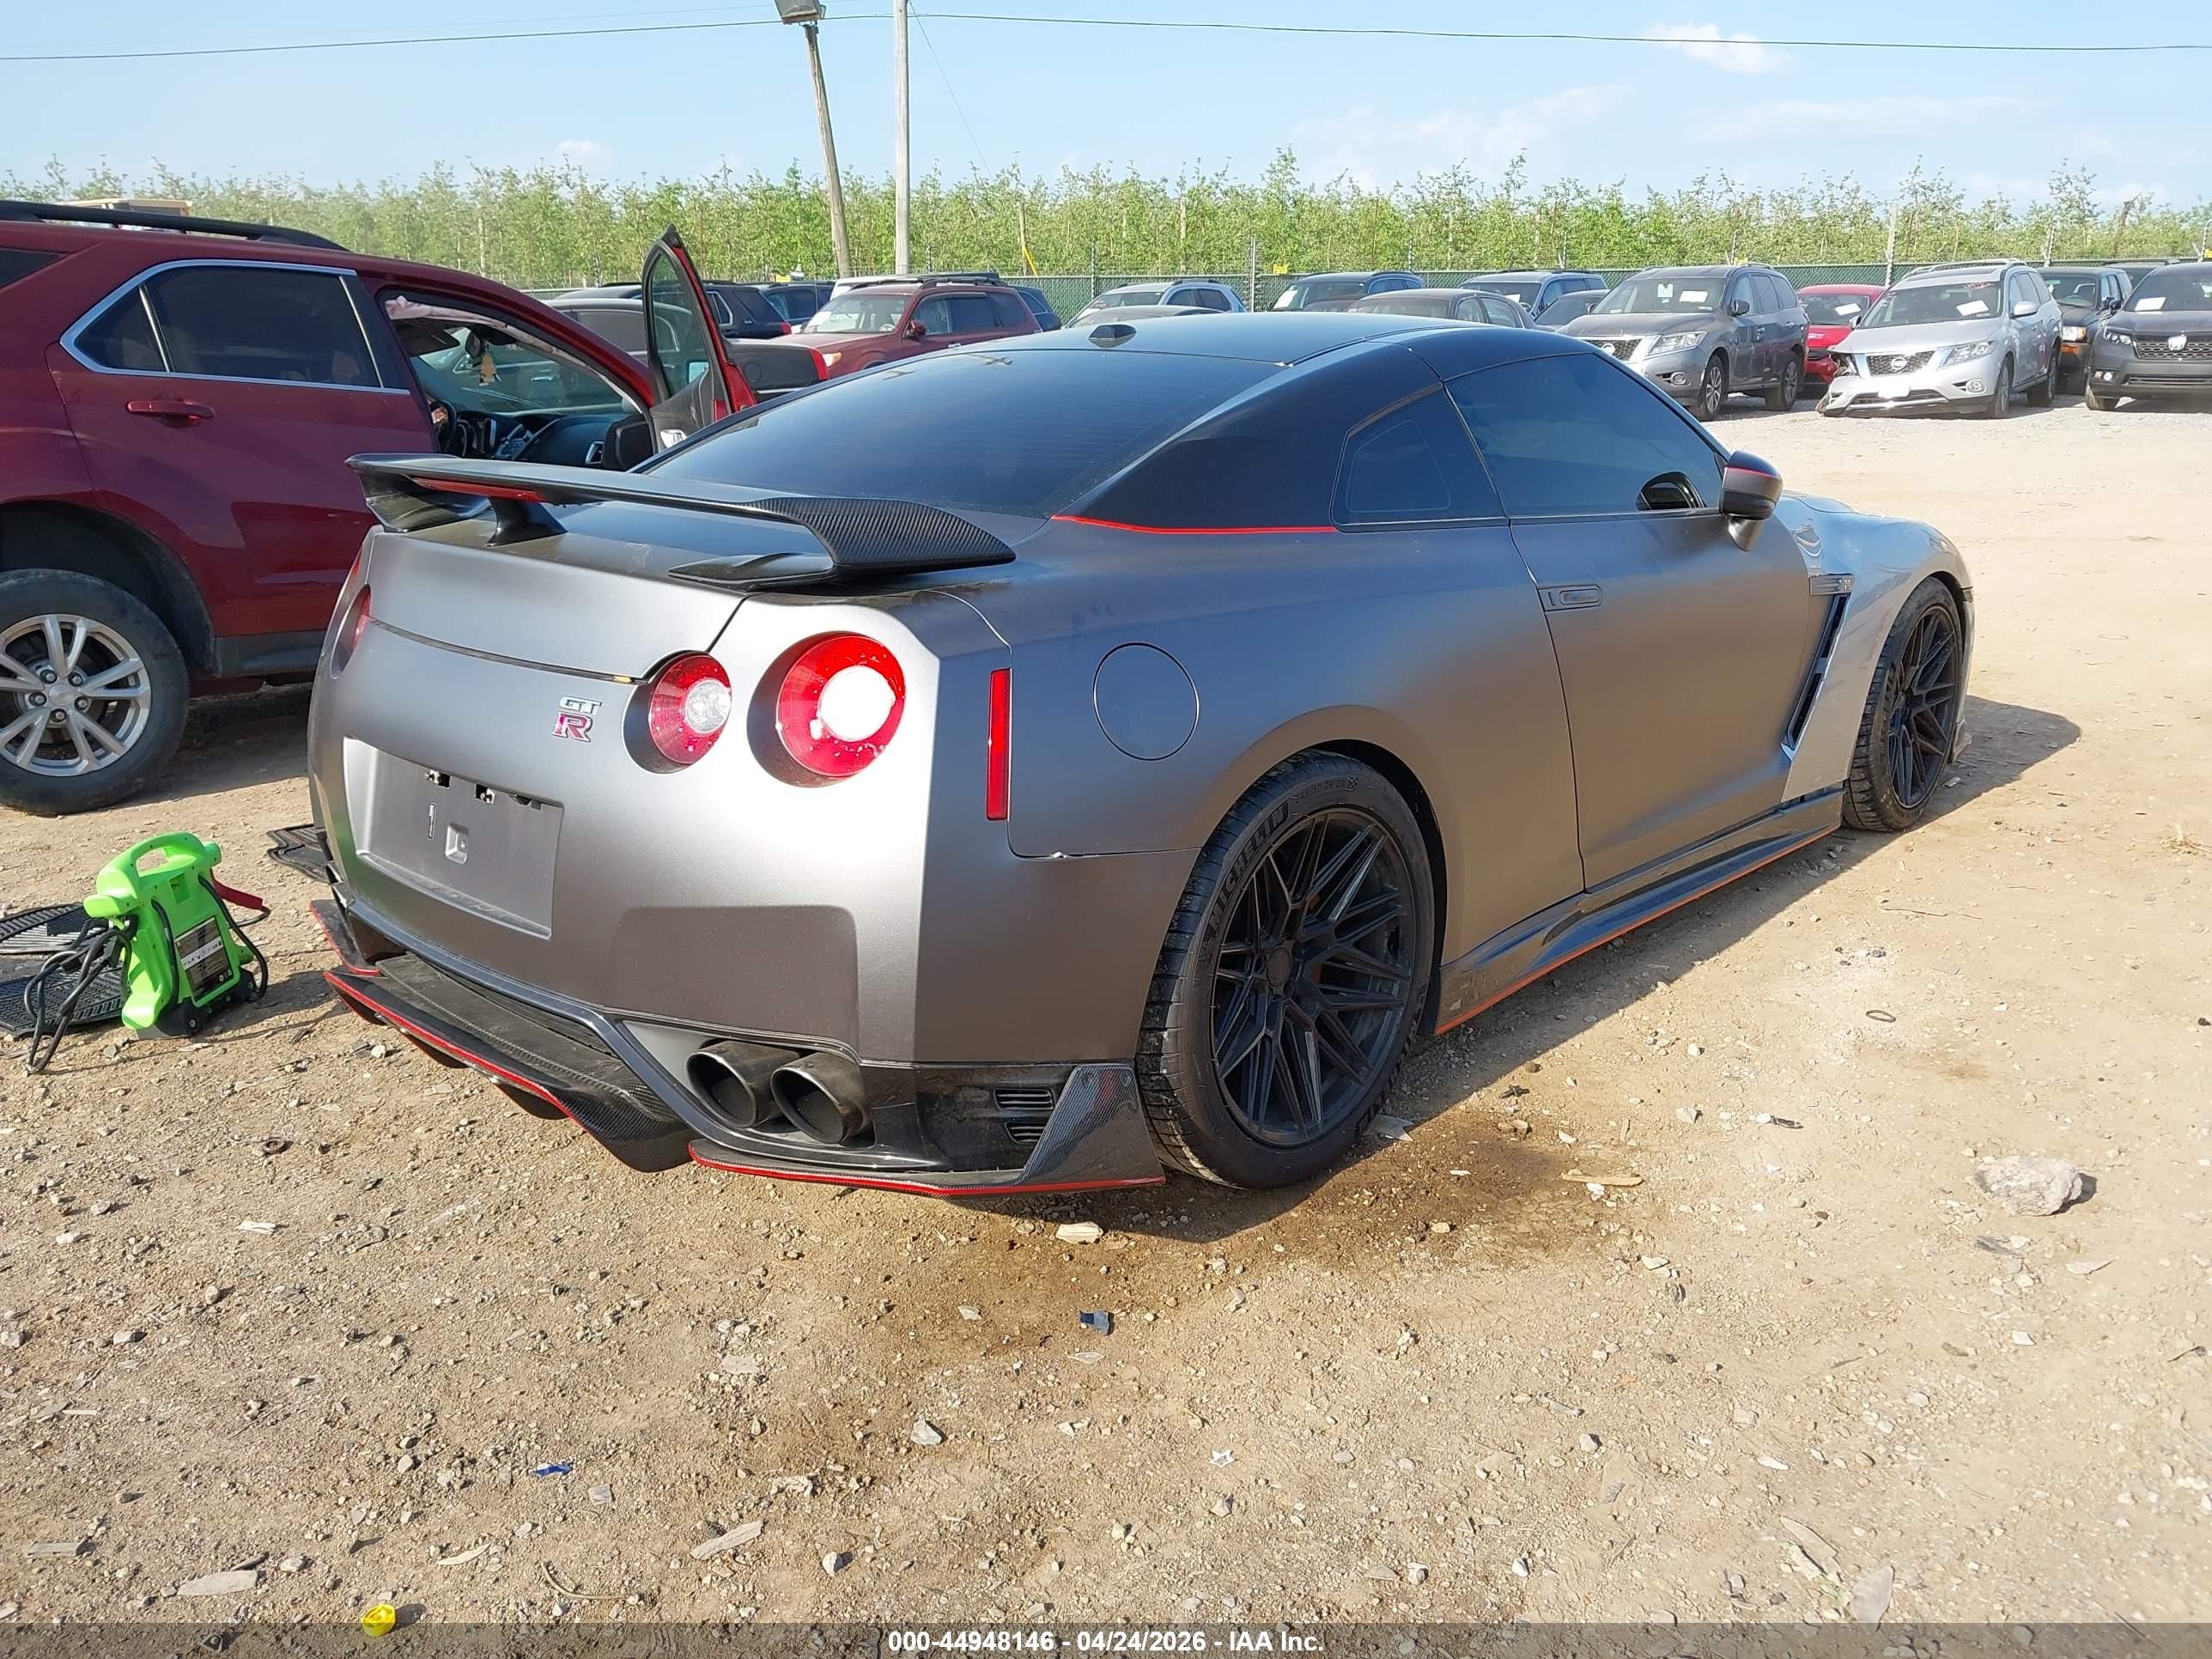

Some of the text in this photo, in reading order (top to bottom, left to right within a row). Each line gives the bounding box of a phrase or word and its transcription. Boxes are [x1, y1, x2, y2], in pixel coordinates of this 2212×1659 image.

[559, 696, 603, 714] GT
[551, 711, 592, 743] R
[1207, 800, 1289, 931] MICHELIN
